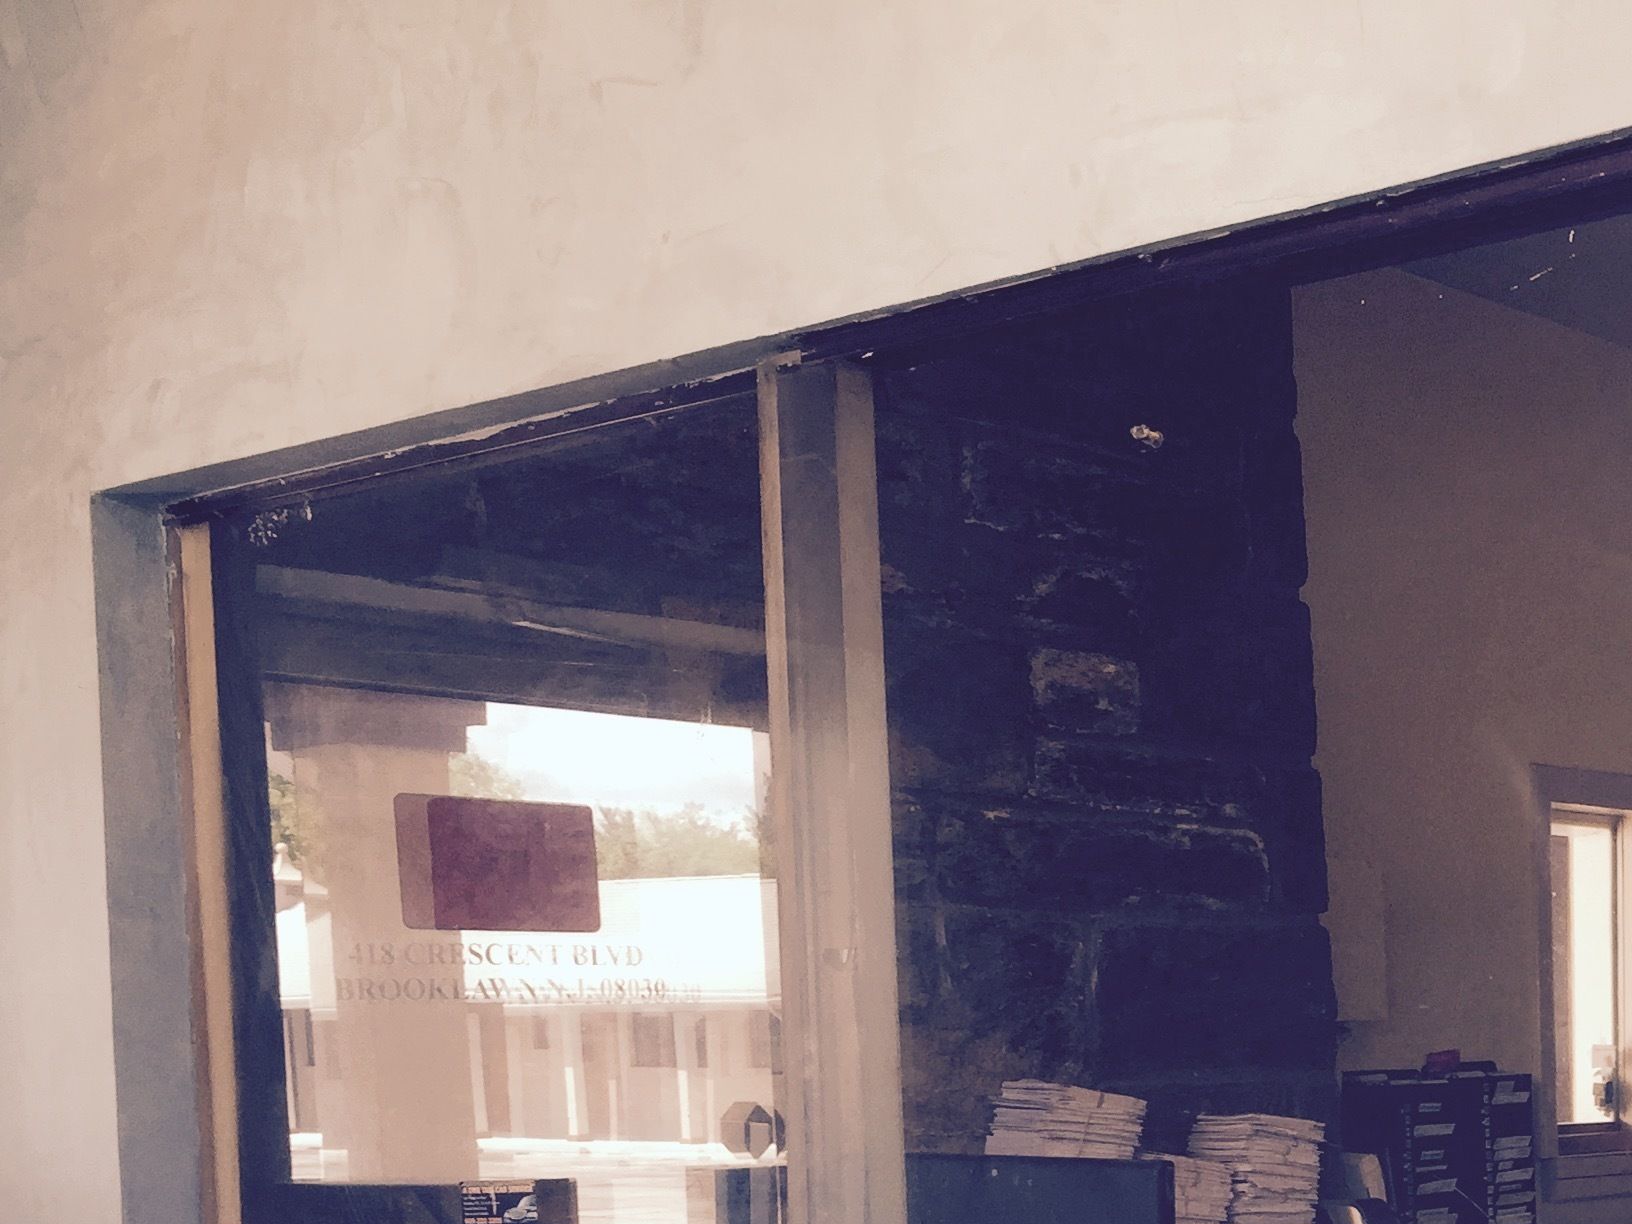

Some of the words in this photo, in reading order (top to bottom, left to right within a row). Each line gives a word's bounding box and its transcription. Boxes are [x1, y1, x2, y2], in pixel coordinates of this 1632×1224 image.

[349, 943, 394, 965] 418
[404, 943, 559, 966] CRESCENT
[572, 945, 642, 966] BLVD
[600, 979, 666, 1001] 08030
